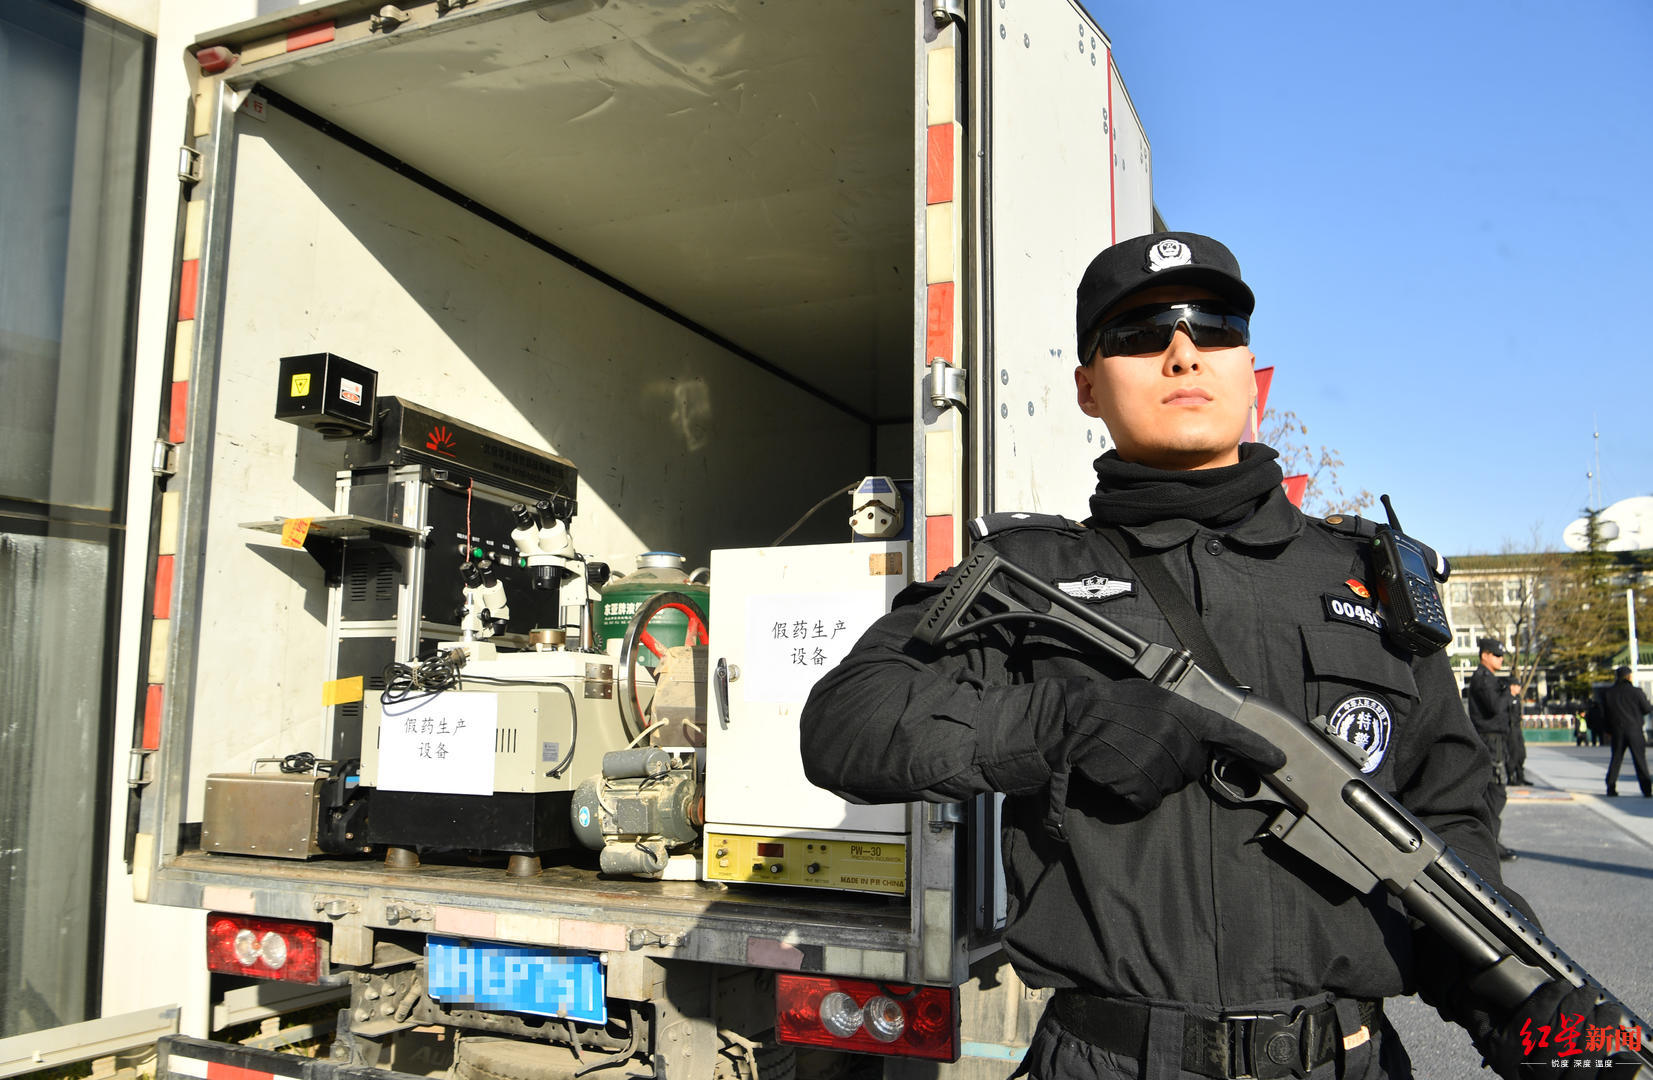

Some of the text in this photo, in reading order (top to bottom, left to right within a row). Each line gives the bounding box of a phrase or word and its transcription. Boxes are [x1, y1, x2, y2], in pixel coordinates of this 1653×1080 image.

[771, 619, 847, 640] 假药生产
[790, 646, 828, 666] 设备
[404, 717, 467, 736] 假药生产
[1354, 712, 1371, 748] 特警
[418, 742, 449, 760] 设备
[840, 876, 859, 884] MADE
[882, 880, 905, 888] CHINA
